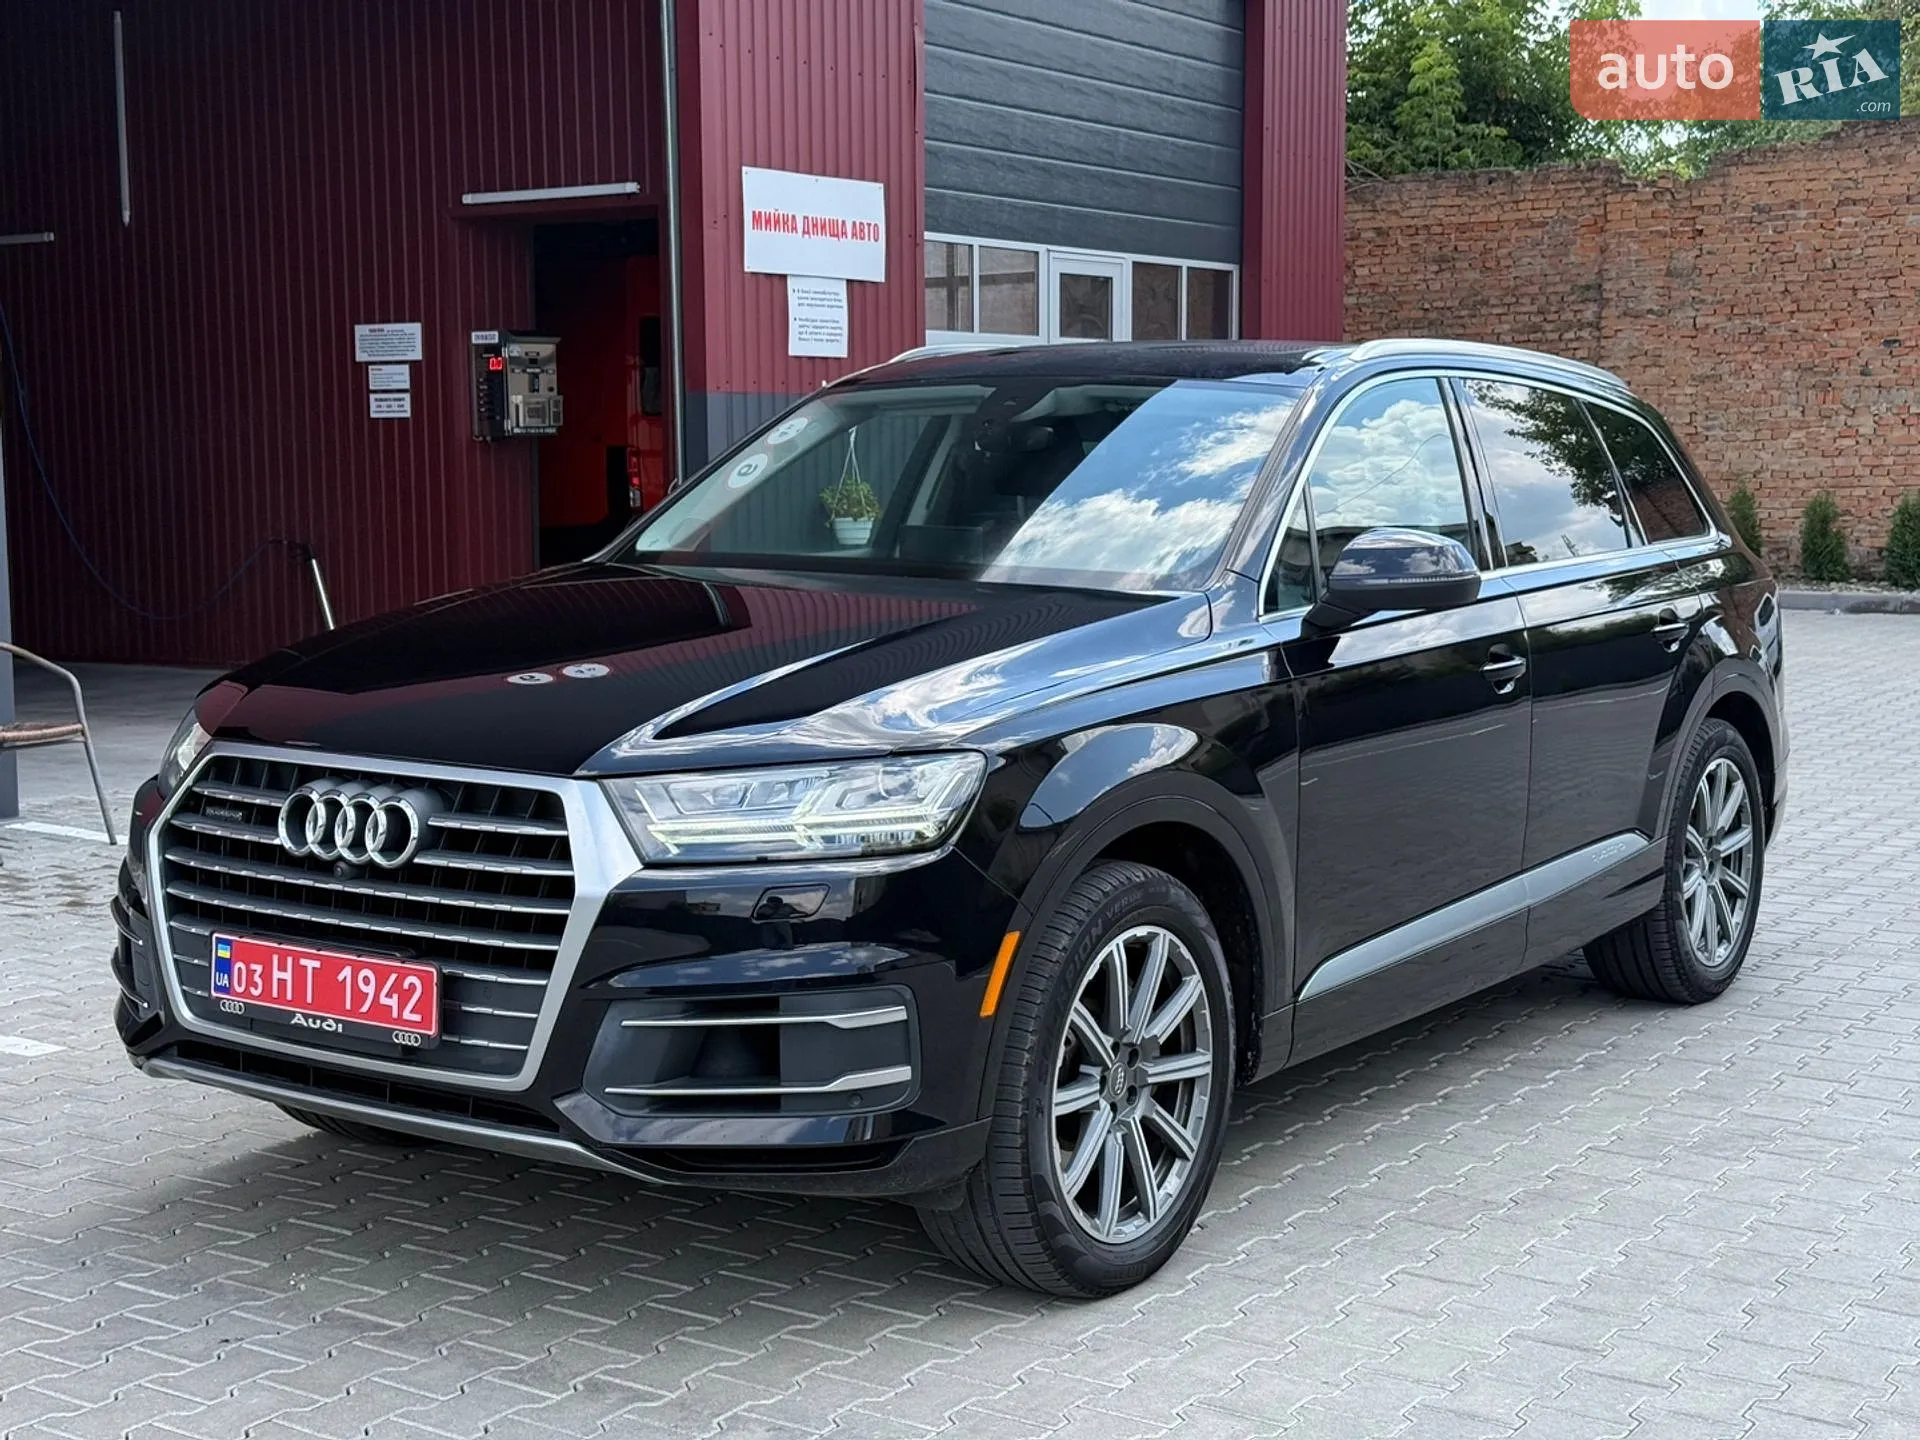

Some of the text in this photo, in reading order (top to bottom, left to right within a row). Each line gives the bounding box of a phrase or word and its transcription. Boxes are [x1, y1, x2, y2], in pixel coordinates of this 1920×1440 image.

[751, 209, 880, 242] МИЙКА ДНИЩА АВТО
[215, 971, 230, 988] UA
[233, 953, 423, 1023] 03 HT 1942
[289, 1013, 343, 1033] Audi
